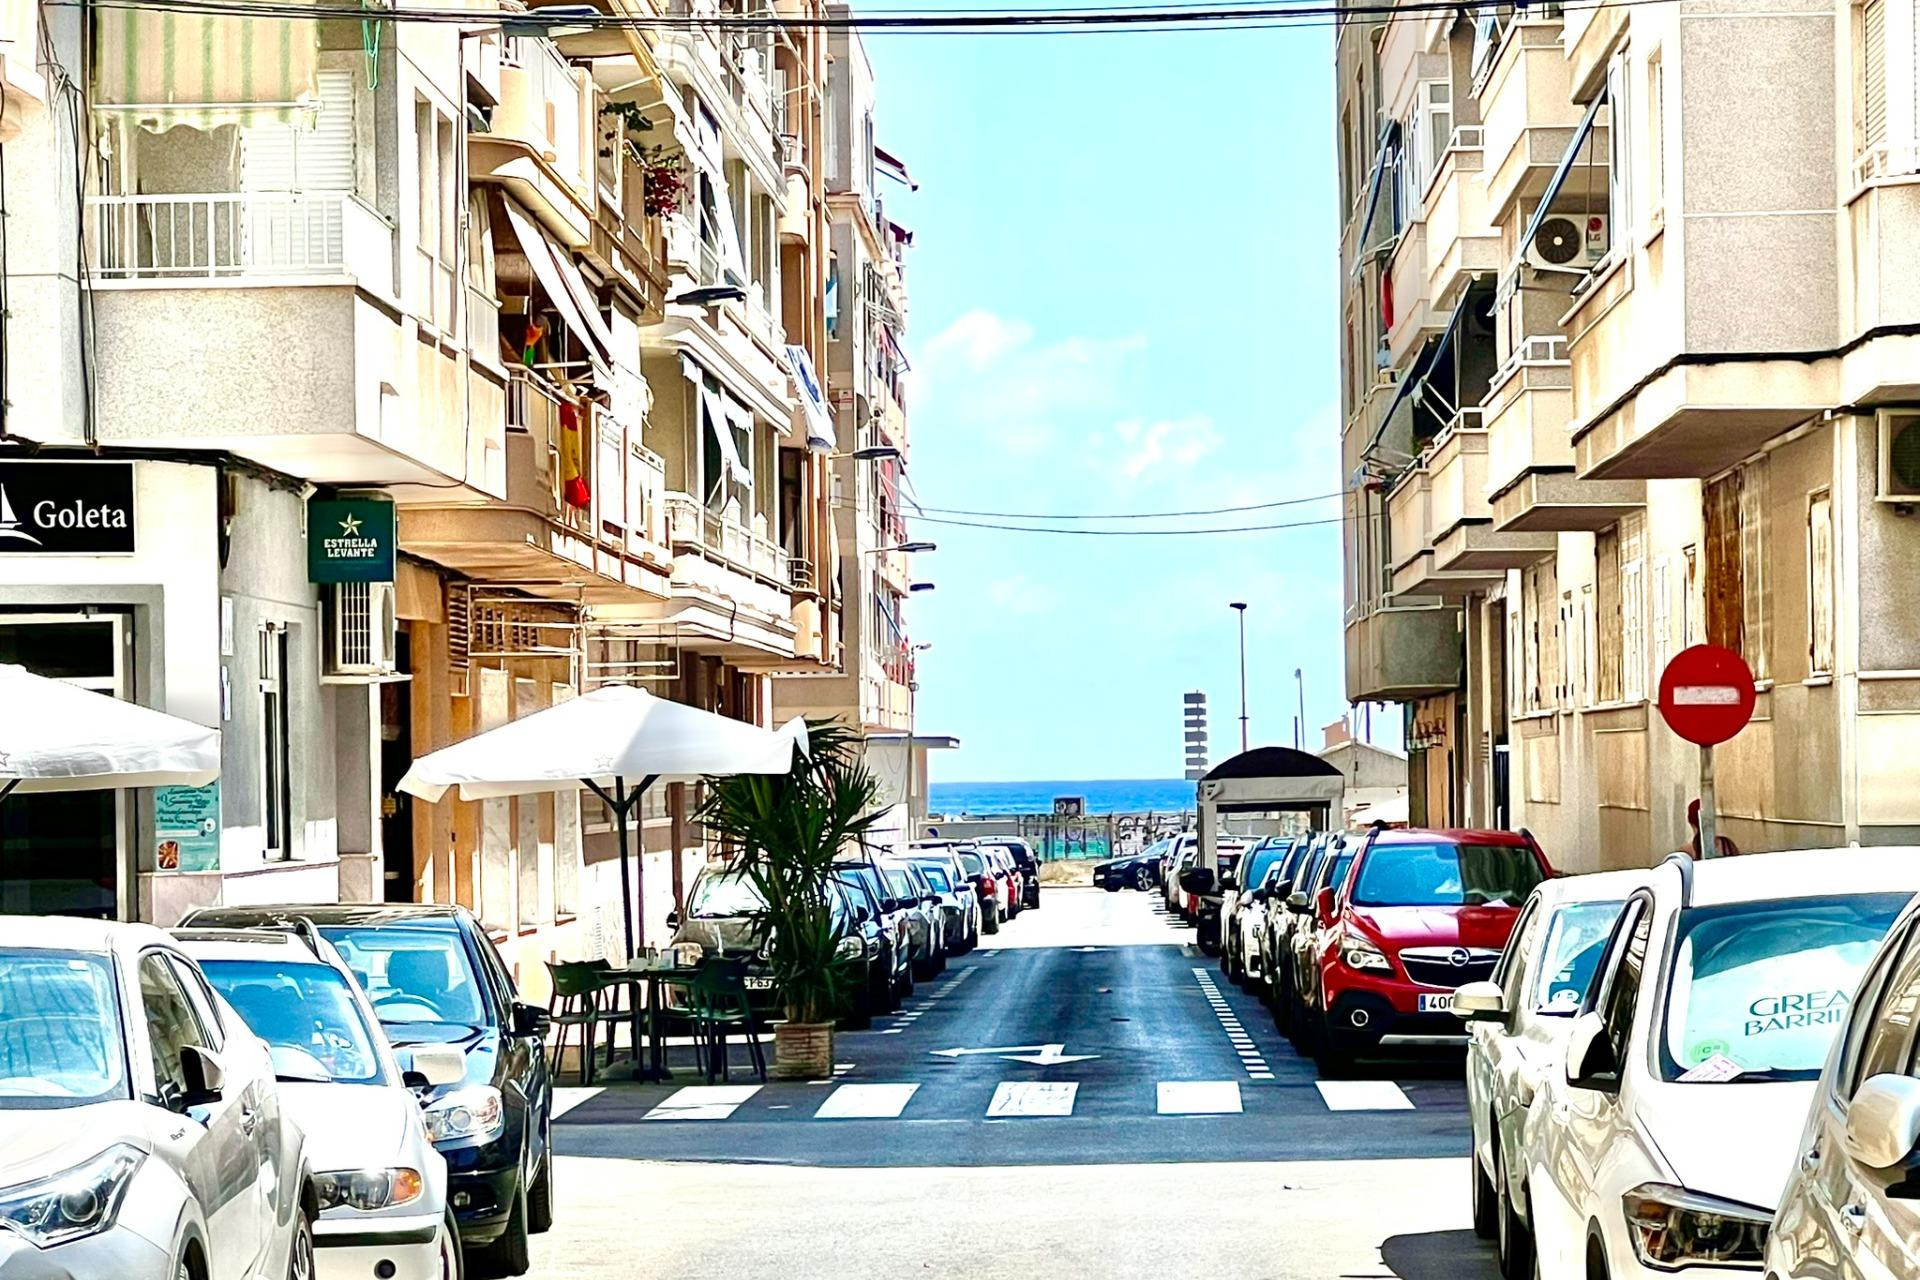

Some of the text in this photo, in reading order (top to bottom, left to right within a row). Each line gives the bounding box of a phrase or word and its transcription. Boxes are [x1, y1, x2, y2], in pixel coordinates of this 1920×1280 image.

[33, 499, 127, 528] Goleta
[324, 538, 378, 549] ESTRELLA
[327, 548, 375, 558] LEVANTE
[1749, 990, 1850, 1017] GREA
[1744, 1009, 1841, 1036] BARRI
